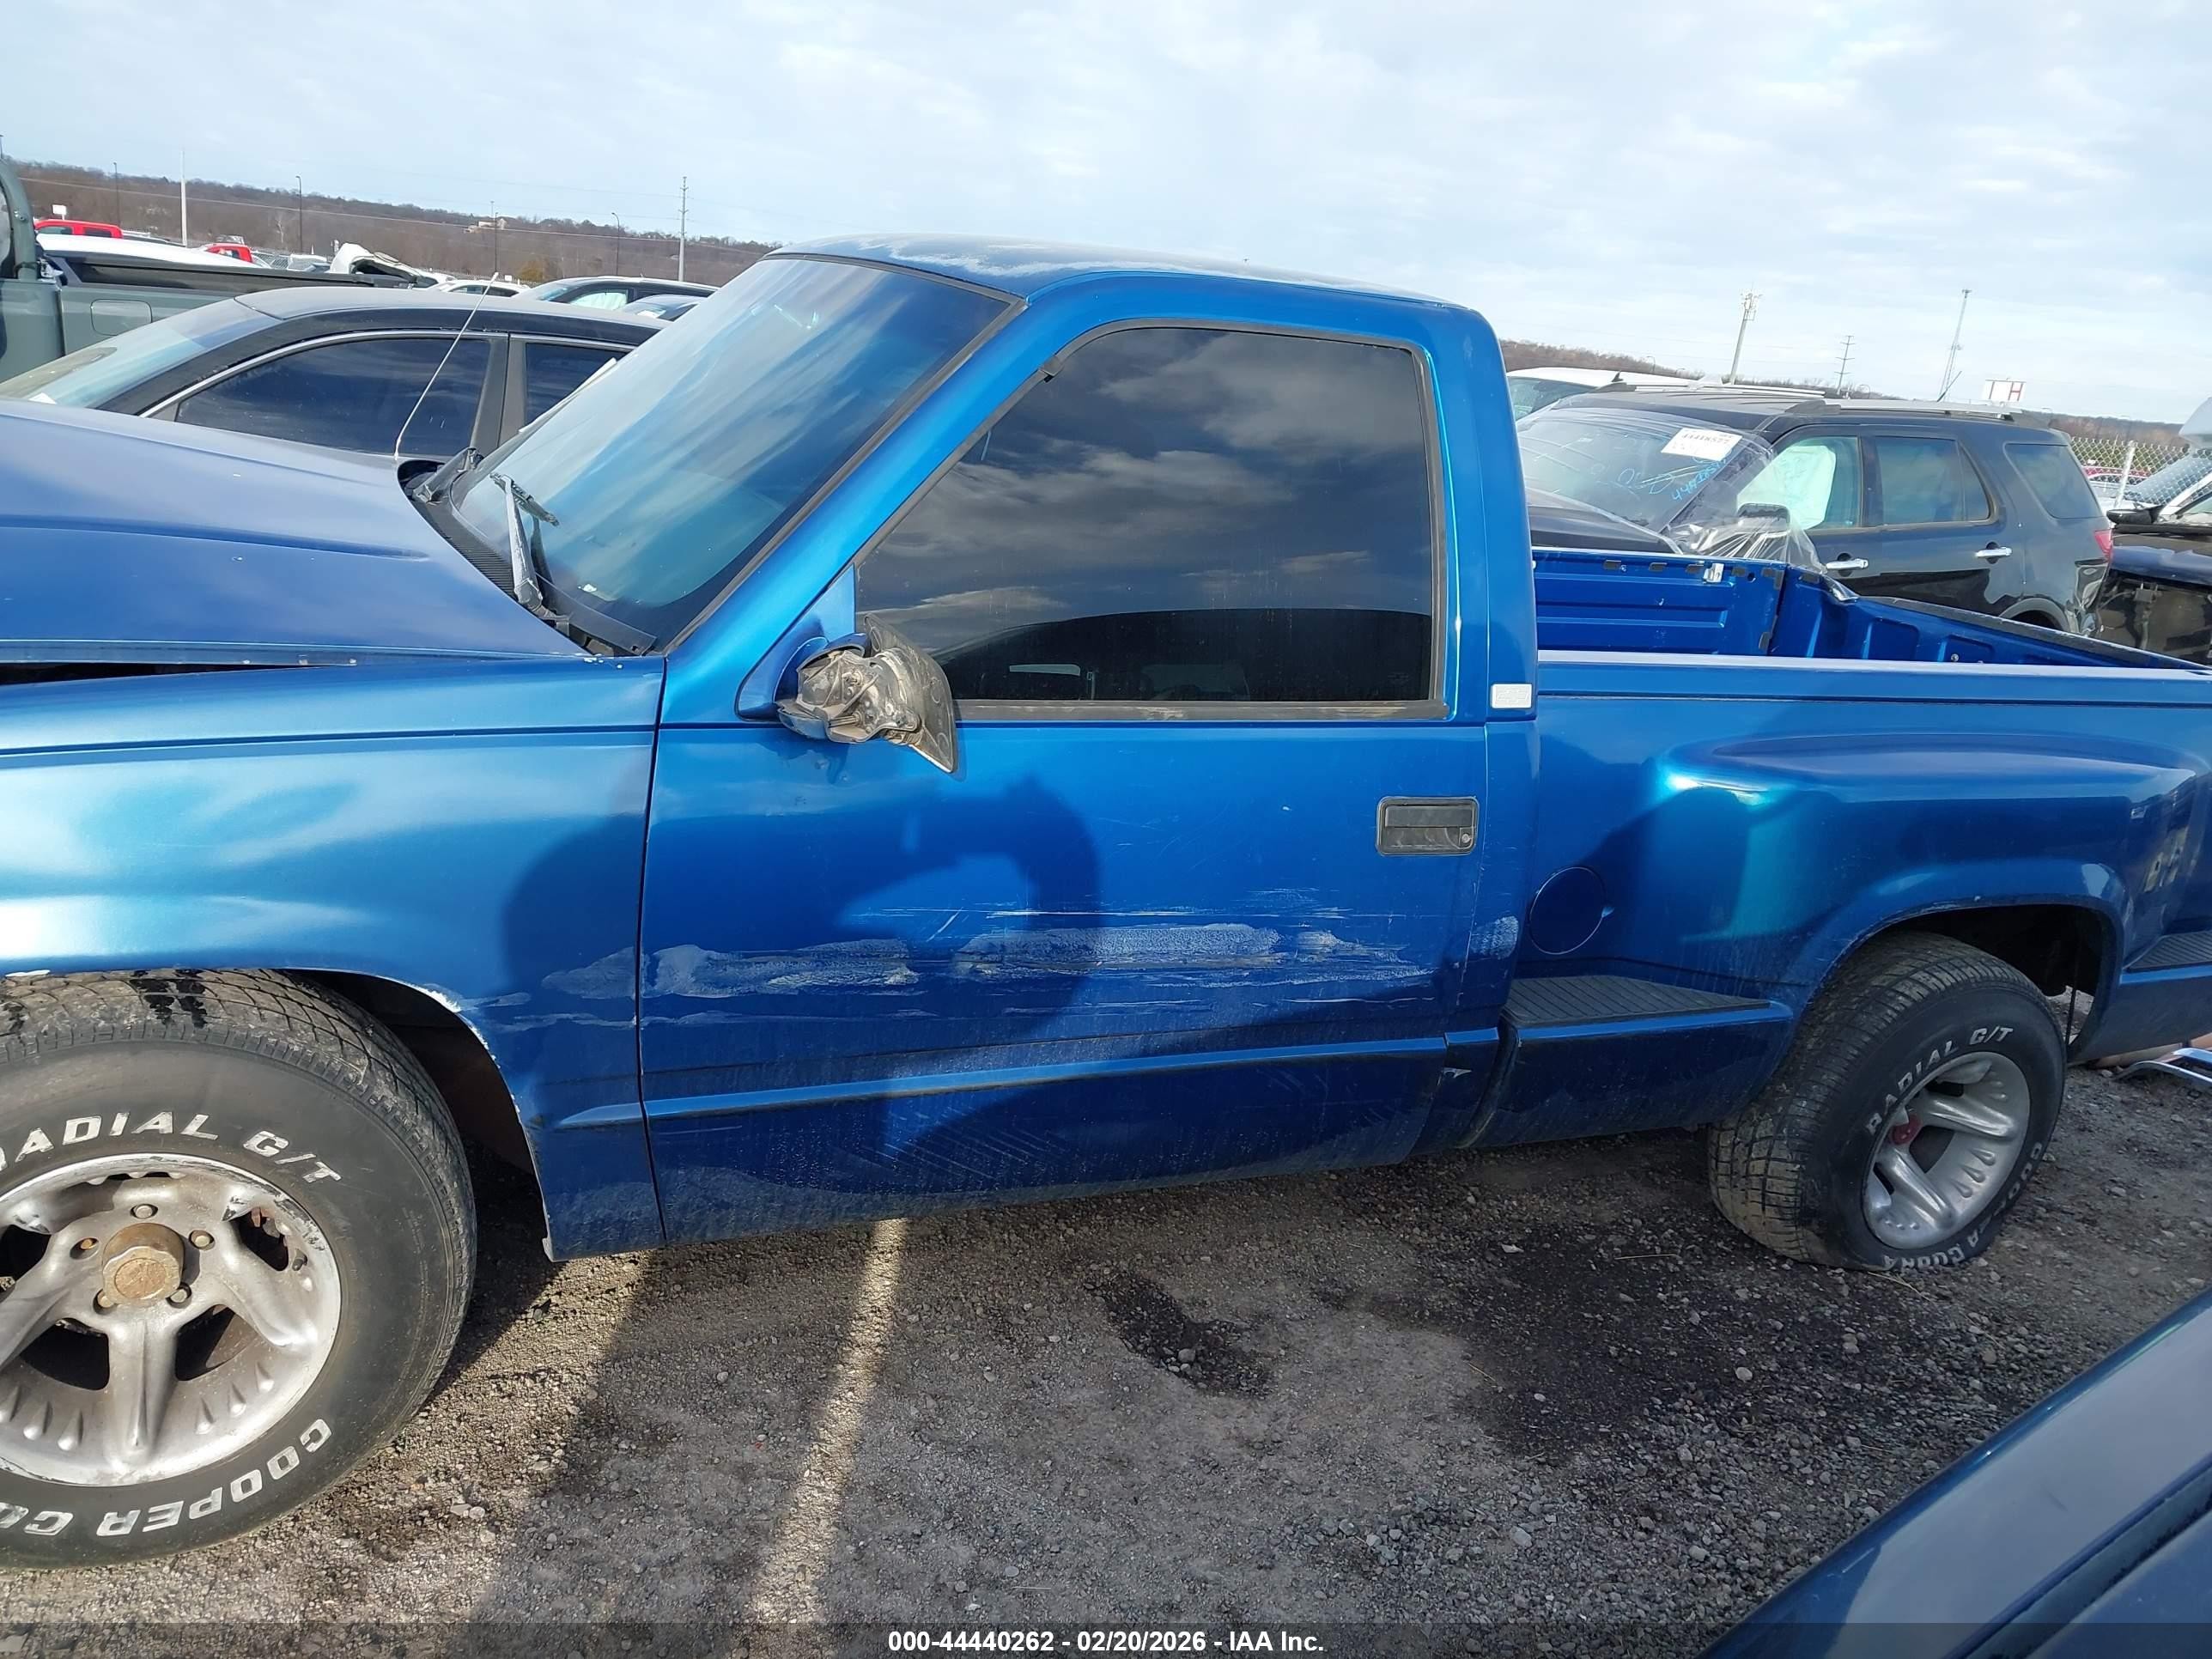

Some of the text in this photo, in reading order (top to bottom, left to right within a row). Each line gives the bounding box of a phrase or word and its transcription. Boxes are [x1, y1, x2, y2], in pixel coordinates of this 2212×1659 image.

[1865, 1025, 2014, 1136] RADIAL G/T
[243, 1130, 342, 1184] G/T
[1966, 1142, 2043, 1248] COOR
[95, 1419, 332, 1536] COOPER
